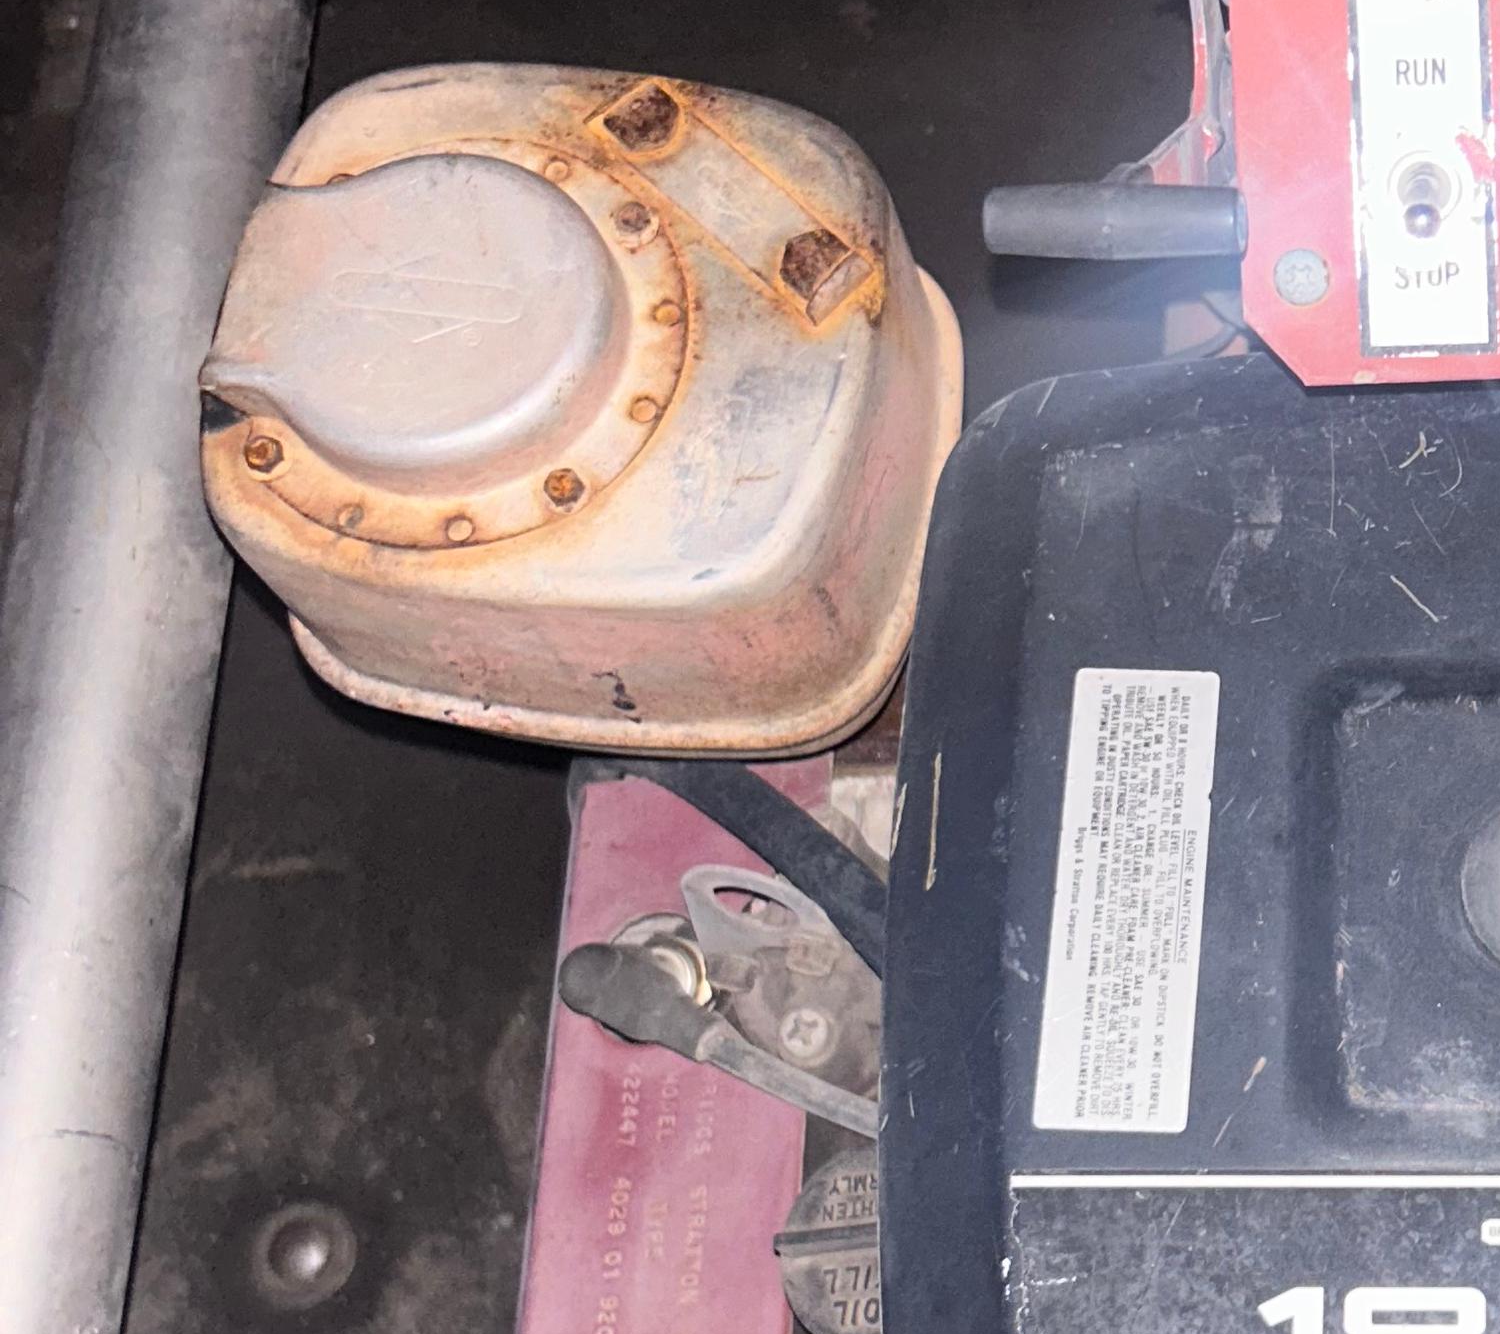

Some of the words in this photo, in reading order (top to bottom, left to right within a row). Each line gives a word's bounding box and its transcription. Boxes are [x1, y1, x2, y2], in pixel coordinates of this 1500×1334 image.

[1396, 58, 1447, 86] RUN
[1395, 261, 1460, 290] STOP
[1103, 685, 1112, 695] TO
[1125, 685, 1136, 719] TRIBUTE
[1136, 685, 1146, 719] REMOVE
[1170, 687, 1180, 711] WHEN
[1099, 699, 1111, 732] TIPPING
[1109, 694, 1122, 741] OPERATING
[1146, 697, 1155, 713] USE
[1156, 695, 1166, 728] WEEKLY
[1180, 696, 1191, 720] DAILY
[1134, 722, 1143, 740] AND
[1145, 717, 1154, 732] SAE
[1166, 716, 1178, 758] EQUIPPED
[1179, 723, 1189, 735] OR
[1096, 736, 1107, 766] ENGINE
[1108, 744, 1117, 753] IN
[1154, 734, 1163, 745] OR
[1120, 740, 1131, 767] PAPER
[1131, 743, 1141, 768] WASH
[1095, 770, 1104, 782] OR
[1106, 756, 1116, 783] DUSTY
[1130, 771, 1139, 780] IN
[1164, 763, 1174, 785] WITH
[1126, 783, 1138, 834] DETERGENT
[1162, 789, 1172, 802] OIL
[1173, 782, 1184, 809] CHECK
[1101, 785, 1114, 837] CONDITIONS
[1160, 807, 1171, 825] FILL
[1074, 827, 1087, 854] Briggs
[1113, 822, 1124, 850] CLEAN
[1124, 837, 1133, 855] AND
[1135, 827, 1144, 841] AIR
[1145, 824, 1156, 858] CHANGE
[1158, 830, 1169, 853] PLUG
[1099, 841, 1109, 860] MAY
[1112, 852, 1121, 864] OR
[1132, 844, 1143, 883] CLEANER
[1184, 830, 1197, 873] ENGINE
[1069, 868, 1083, 904] Stratton
[1095, 863, 1107, 901] REQUIRE
[1108, 867, 1120, 905] REPLACE
[1155, 871, 1166, 889] FILL
[1167, 864, 1178, 881] FILL
[1119, 896, 1128, 914] DRY
[1154, 894, 1164, 905] TO
[1166, 886, 1176, 897] TO
[1092, 904, 1103, 930] DAILY
[1139, 888, 1151, 928] SUMMER
[1178, 879, 1193, 964] MAINTENANCE
[1064, 908, 1079, 961] Corporation
[1105, 908, 1117, 936] EVERY
[1127, 917, 1137, 942] FOAM
[1113, 918, 1126, 979] THOROUGHLY
[1136, 950, 1146, 967] USE
[1161, 939, 1172, 964] MARK
[1134, 974, 1144, 990] SAE
[1160, 969, 1170, 981] ON
[1084, 984, 1096, 1022] REMOVE
[1100, 981, 1110, 999] TAP
[1111, 982, 1121, 1001] AND
[1096, 1001, 1108, 1036] GENTLY
[1118, 1015, 1129, 1044] CLEAN
[1082, 1025, 1092, 1041] AIR
[1095, 1039, 1105, 1050] TO
[1078, 1044, 1090, 1086] CLEANER
[1091, 1053, 1104, 1093] REMOVE
[1104, 1040, 1116, 1082] SQUEEZE
[1115, 1048, 1126, 1077] EVERY
[1075, 1089, 1086, 1118] PRIOR
[1103, 1085, 1112, 1097] TO
[1123, 1083, 1135, 1120] WINTER
[823, 1265, 880, 1294] ILL
[833, 1297, 880, 1326] OIL
